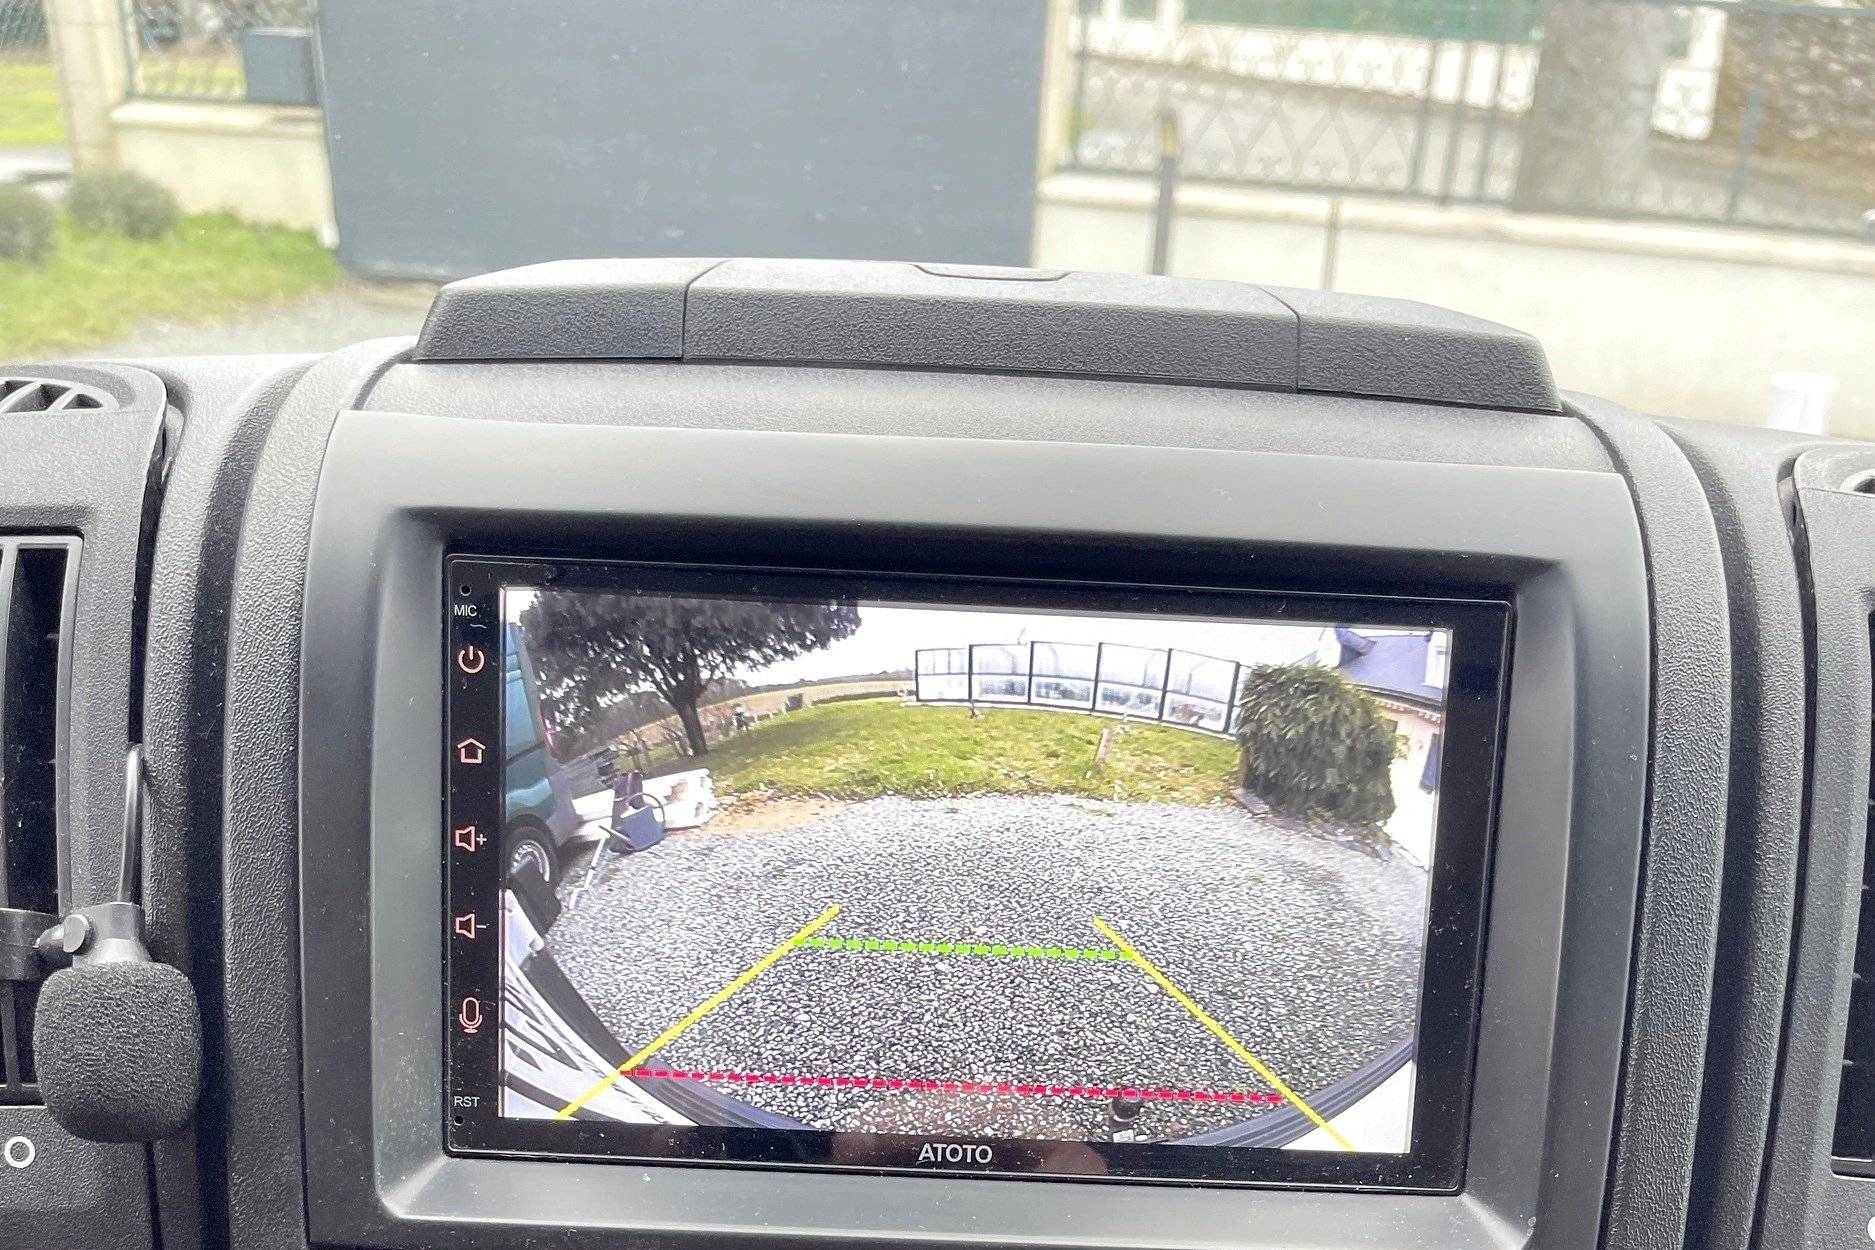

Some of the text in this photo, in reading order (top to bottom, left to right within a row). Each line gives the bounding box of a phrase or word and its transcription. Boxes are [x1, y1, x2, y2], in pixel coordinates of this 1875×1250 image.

[454, 604, 478, 617] MIC
[453, 1095, 480, 1108] RST
[918, 1142, 993, 1164] ATOTO
